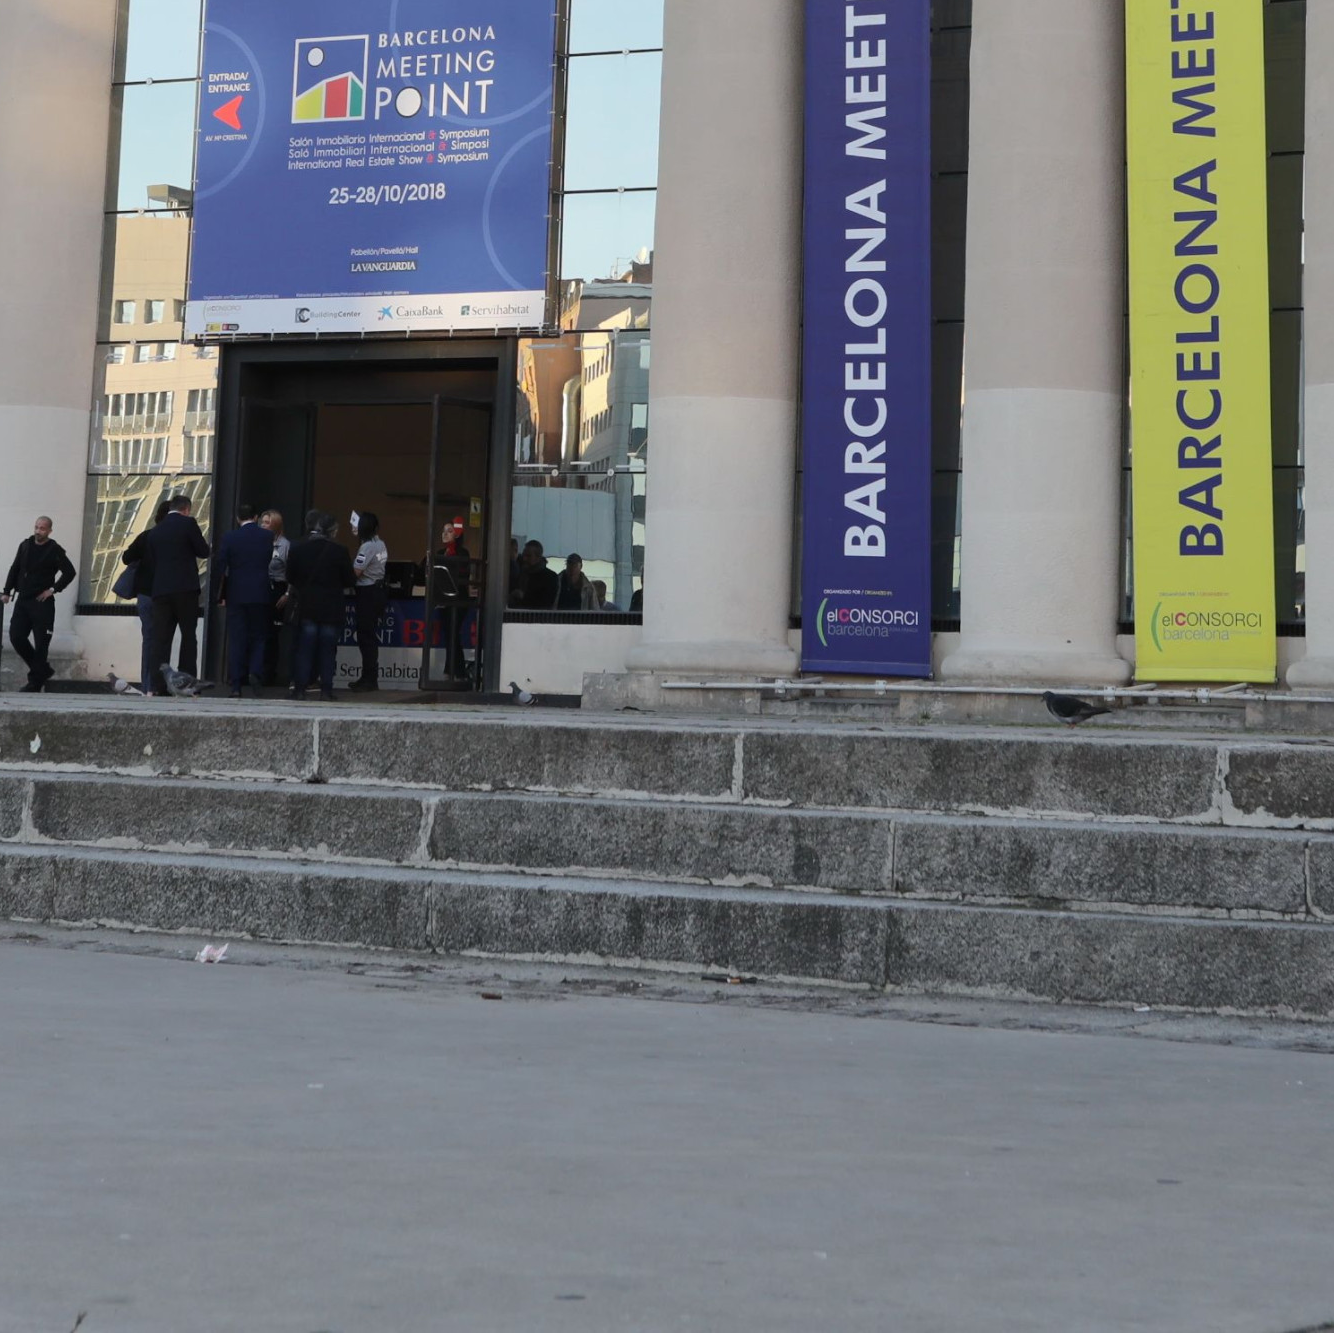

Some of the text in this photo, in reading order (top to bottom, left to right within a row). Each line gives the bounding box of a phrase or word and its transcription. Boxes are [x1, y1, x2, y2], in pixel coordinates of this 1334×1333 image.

[378, 25, 496, 48] BARCELONA
[376, 49, 495, 79] MEETING
[208, 71, 249, 83] ENTRADA/
[208, 82, 251, 94] ENTRANCE
[374, 79, 494, 120] POINT
[289, 136, 313, 147] Salón
[316, 134, 366, 146] Inmobiliario
[369, 131, 426, 143] Internacional
[439, 127, 490, 141] Symposium
[288, 147, 310, 159] Saló
[313, 146, 366, 158] Immobiliari
[370, 142, 435, 155] Internacional
[450, 139, 489, 152] Simposi
[287, 158, 342, 170] International
[345, 157, 365, 167] Real
[368, 156, 395, 167] Estate
[398, 155, 423, 165] Show
[437, 151, 489, 164] Symposium
[328, 182, 446, 206] 25-28/10/2018
[396, 305, 444, 317] CaixaBank
[471, 304, 530, 316] Servihabitat
[843, 178, 888, 558] BARCELONA
[1174, 160, 1224, 556] BARCELONA
[827, 623, 890, 638] barcelona
[1162, 627, 1230, 641] barcelona
